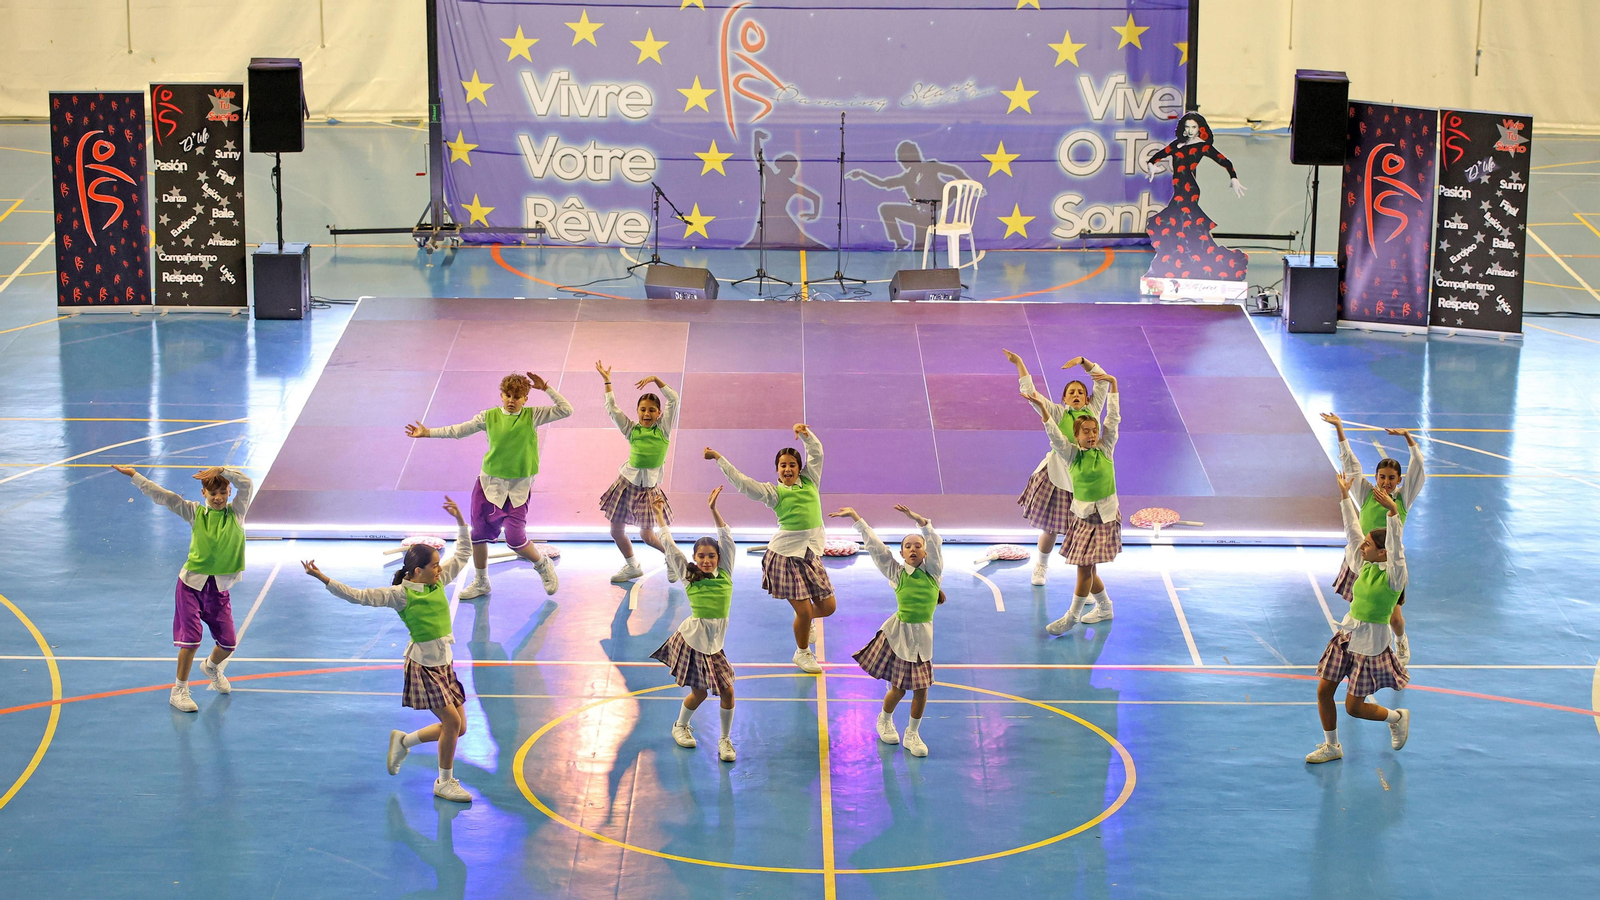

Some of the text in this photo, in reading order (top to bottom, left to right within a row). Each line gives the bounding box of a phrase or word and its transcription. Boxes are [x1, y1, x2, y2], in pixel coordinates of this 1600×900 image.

[213, 88, 236, 99] Vive
[520, 71, 653, 119] Vivre
[770, 83, 889, 112] Dancing
[901, 78, 976, 107] Stars
[1079, 74, 1184, 121] Vive
[219, 100, 230, 110] Tu
[208, 111, 239, 122] Sueño
[1502, 118, 1525, 130] Vive
[1507, 131, 1518, 141] Tu
[1059, 131, 1174, 177] O Te
[1495, 141, 1527, 154] Sueño
[215, 149, 241, 161] Sunny
[518, 134, 657, 183] Votre
[155, 159, 188, 171] Pasión
[216, 169, 236, 186] Final
[1439, 184, 1472, 199] Pasión
[1500, 179, 1526, 192] Sunny
[162, 194, 187, 203] Danza
[212, 208, 235, 218] Baile
[1499, 199, 1519, 217] Final
[526, 197, 650, 245] Rêve
[1052, 192, 1168, 239] Sonh
[170, 215, 197, 237] Europeo
[1444, 220, 1469, 230] Danza
[207, 238, 236, 247] Amistad
[1492, 237, 1516, 250] Baile
[159, 253, 218, 263] Compañerismo
[1449, 243, 1477, 264] Europeo
[162, 272, 204, 285] Respeto
[220, 264, 236, 285] Unión
[1485, 267, 1515, 278] Amistad
[1436, 278, 1496, 292] Compañerismo
[1438, 297, 1480, 312] Respeto
[1496, 294, 1513, 316] Unión
